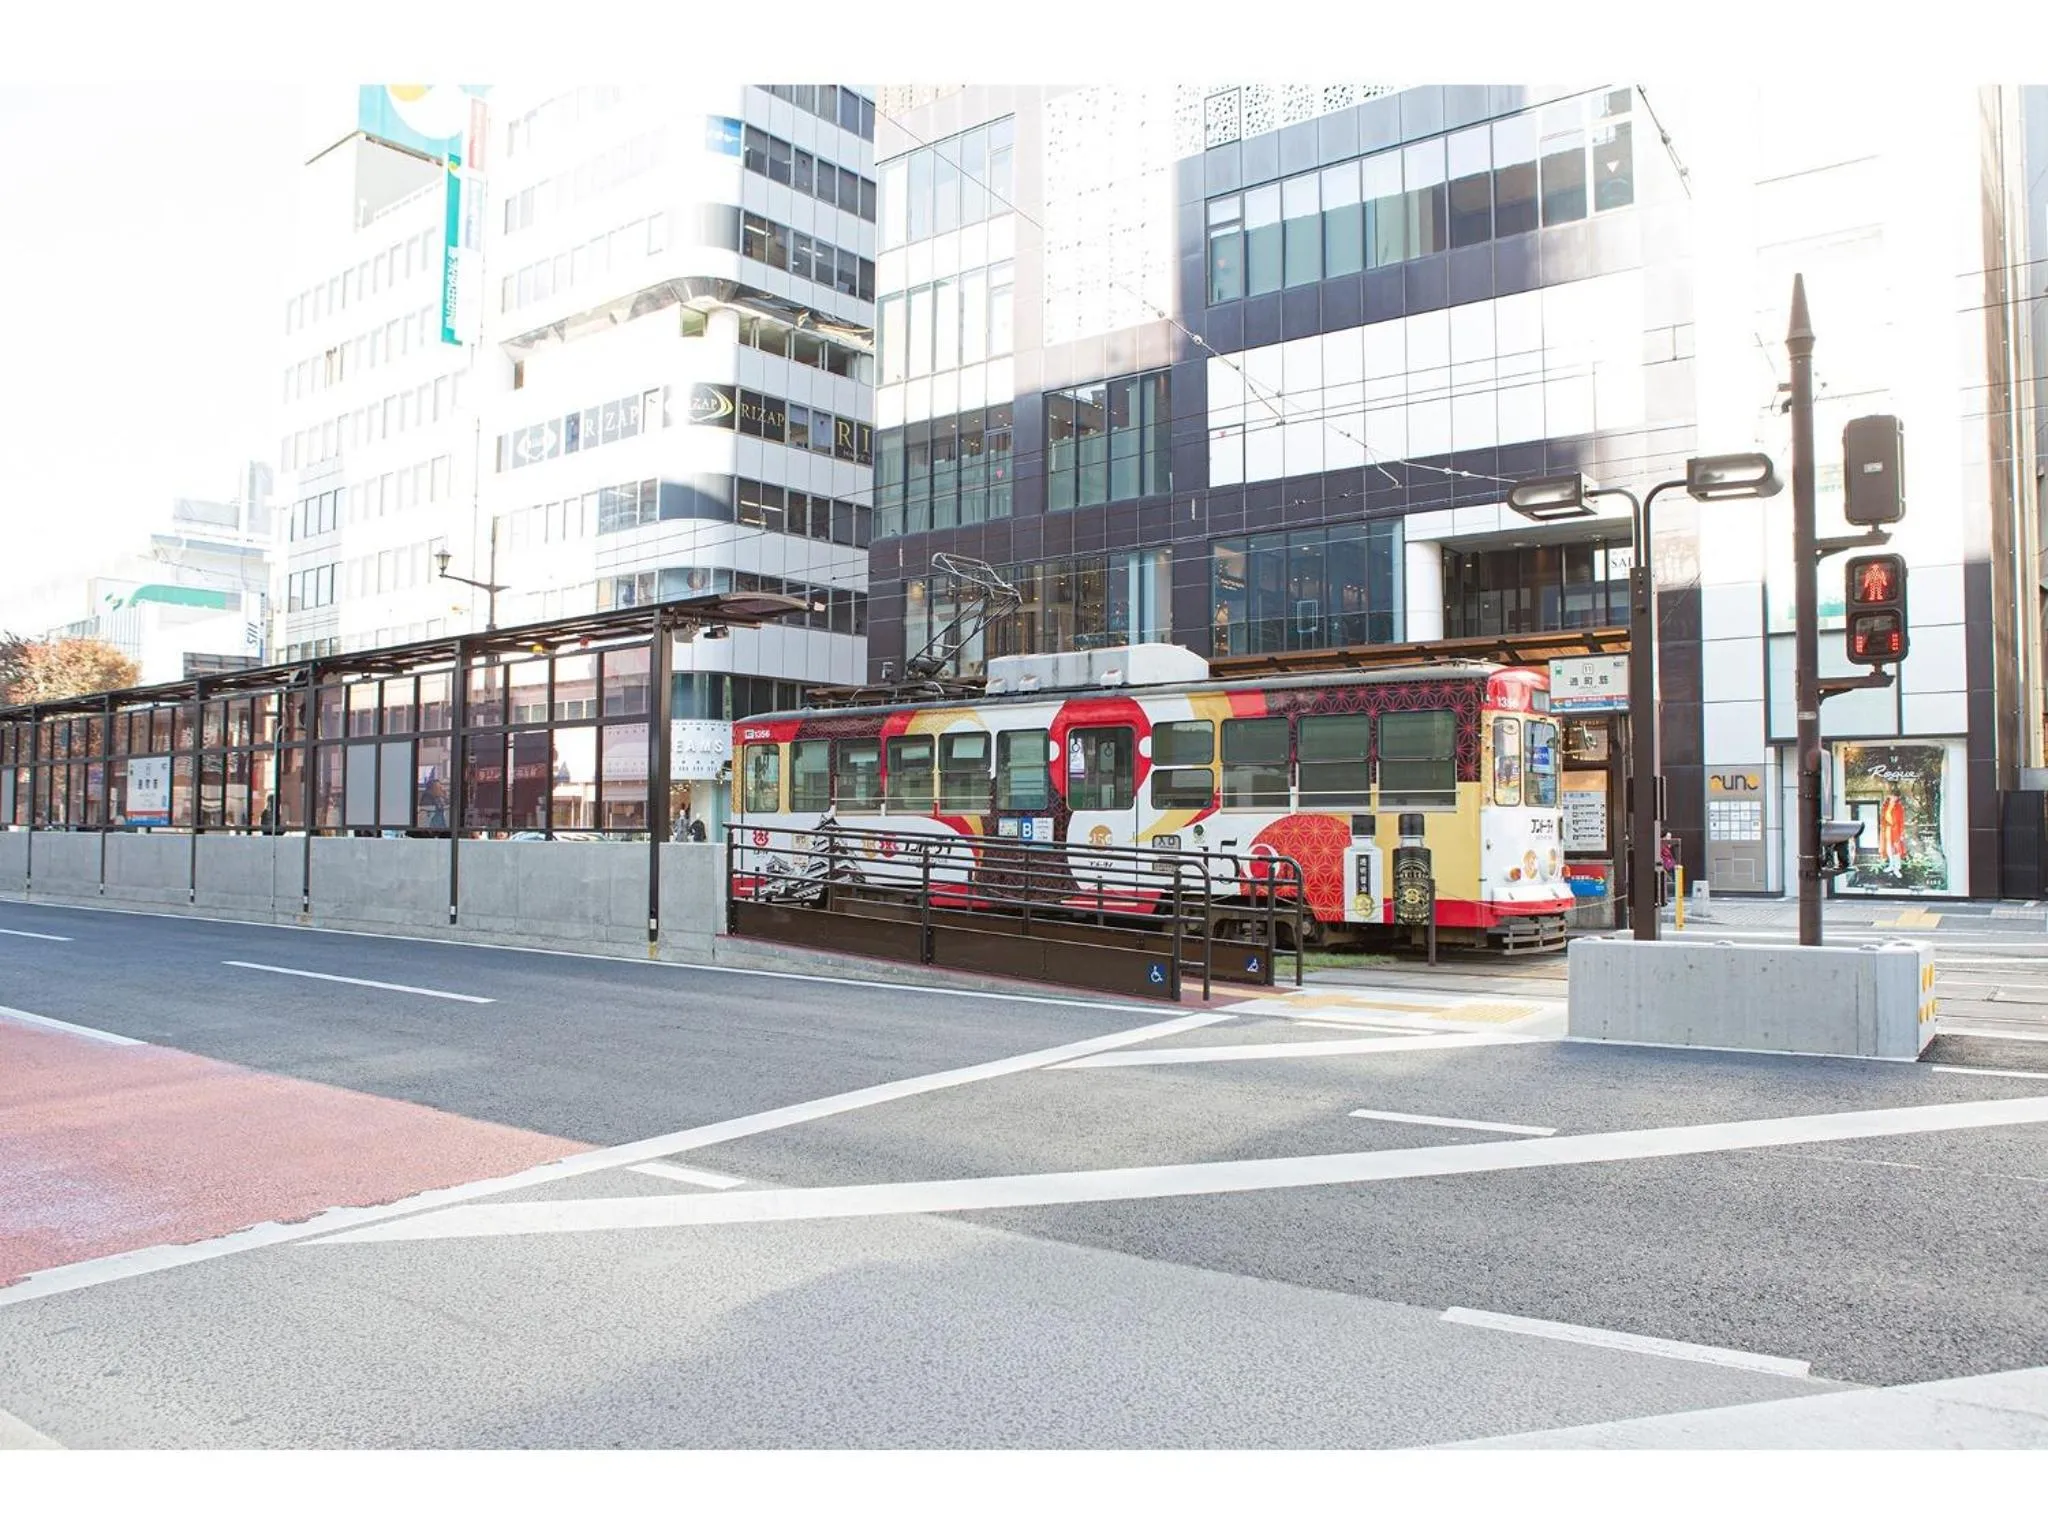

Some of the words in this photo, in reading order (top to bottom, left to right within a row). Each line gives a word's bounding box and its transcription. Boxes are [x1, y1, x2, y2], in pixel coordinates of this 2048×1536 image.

[584, 405, 638, 438] RZAP
[740, 406, 785, 427] RIZAP
[1610, 556, 1635, 569] SAL
[676, 740, 724, 755] EAMS
[1023, 823, 1032, 838] B
